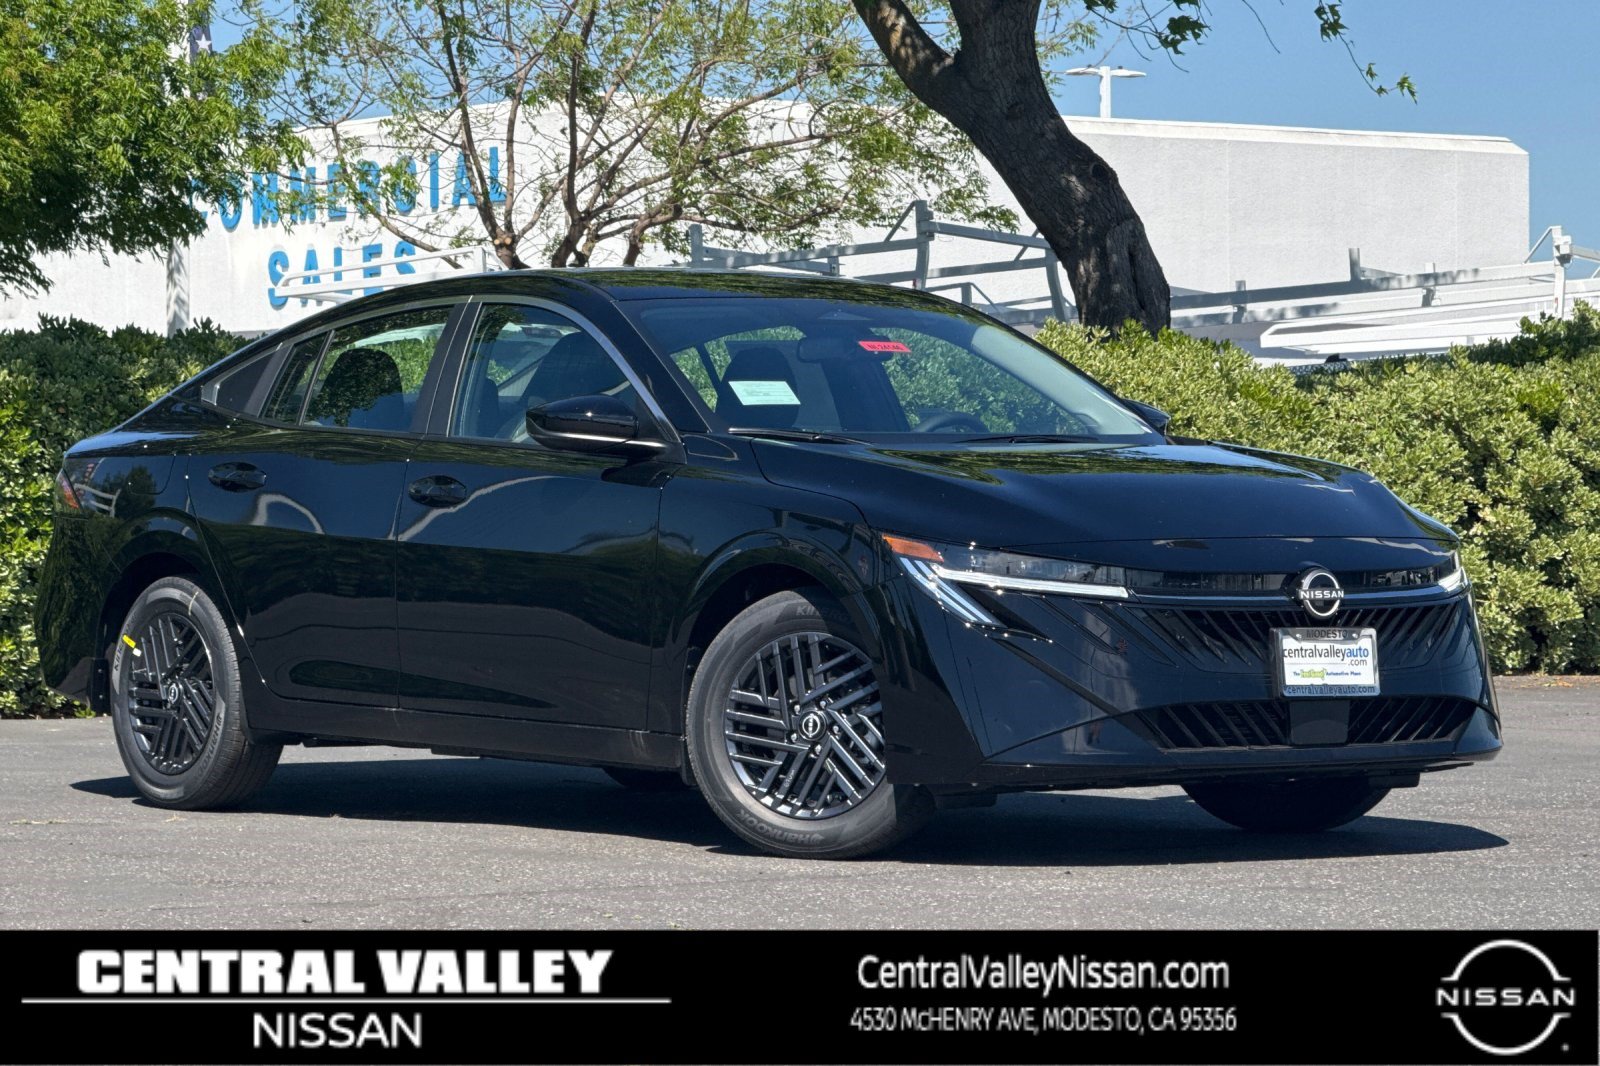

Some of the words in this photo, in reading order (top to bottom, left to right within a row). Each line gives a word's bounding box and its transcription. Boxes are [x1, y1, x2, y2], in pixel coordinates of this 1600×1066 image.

[1300, 590, 1344, 599] NISSAN
[1306, 629, 1348, 639] MODESTO
[1283, 644, 1370, 661] centralvalleyauto
[1348, 659, 1368, 667] .com
[1287, 682, 1376, 695] centralvalleyauto.com
